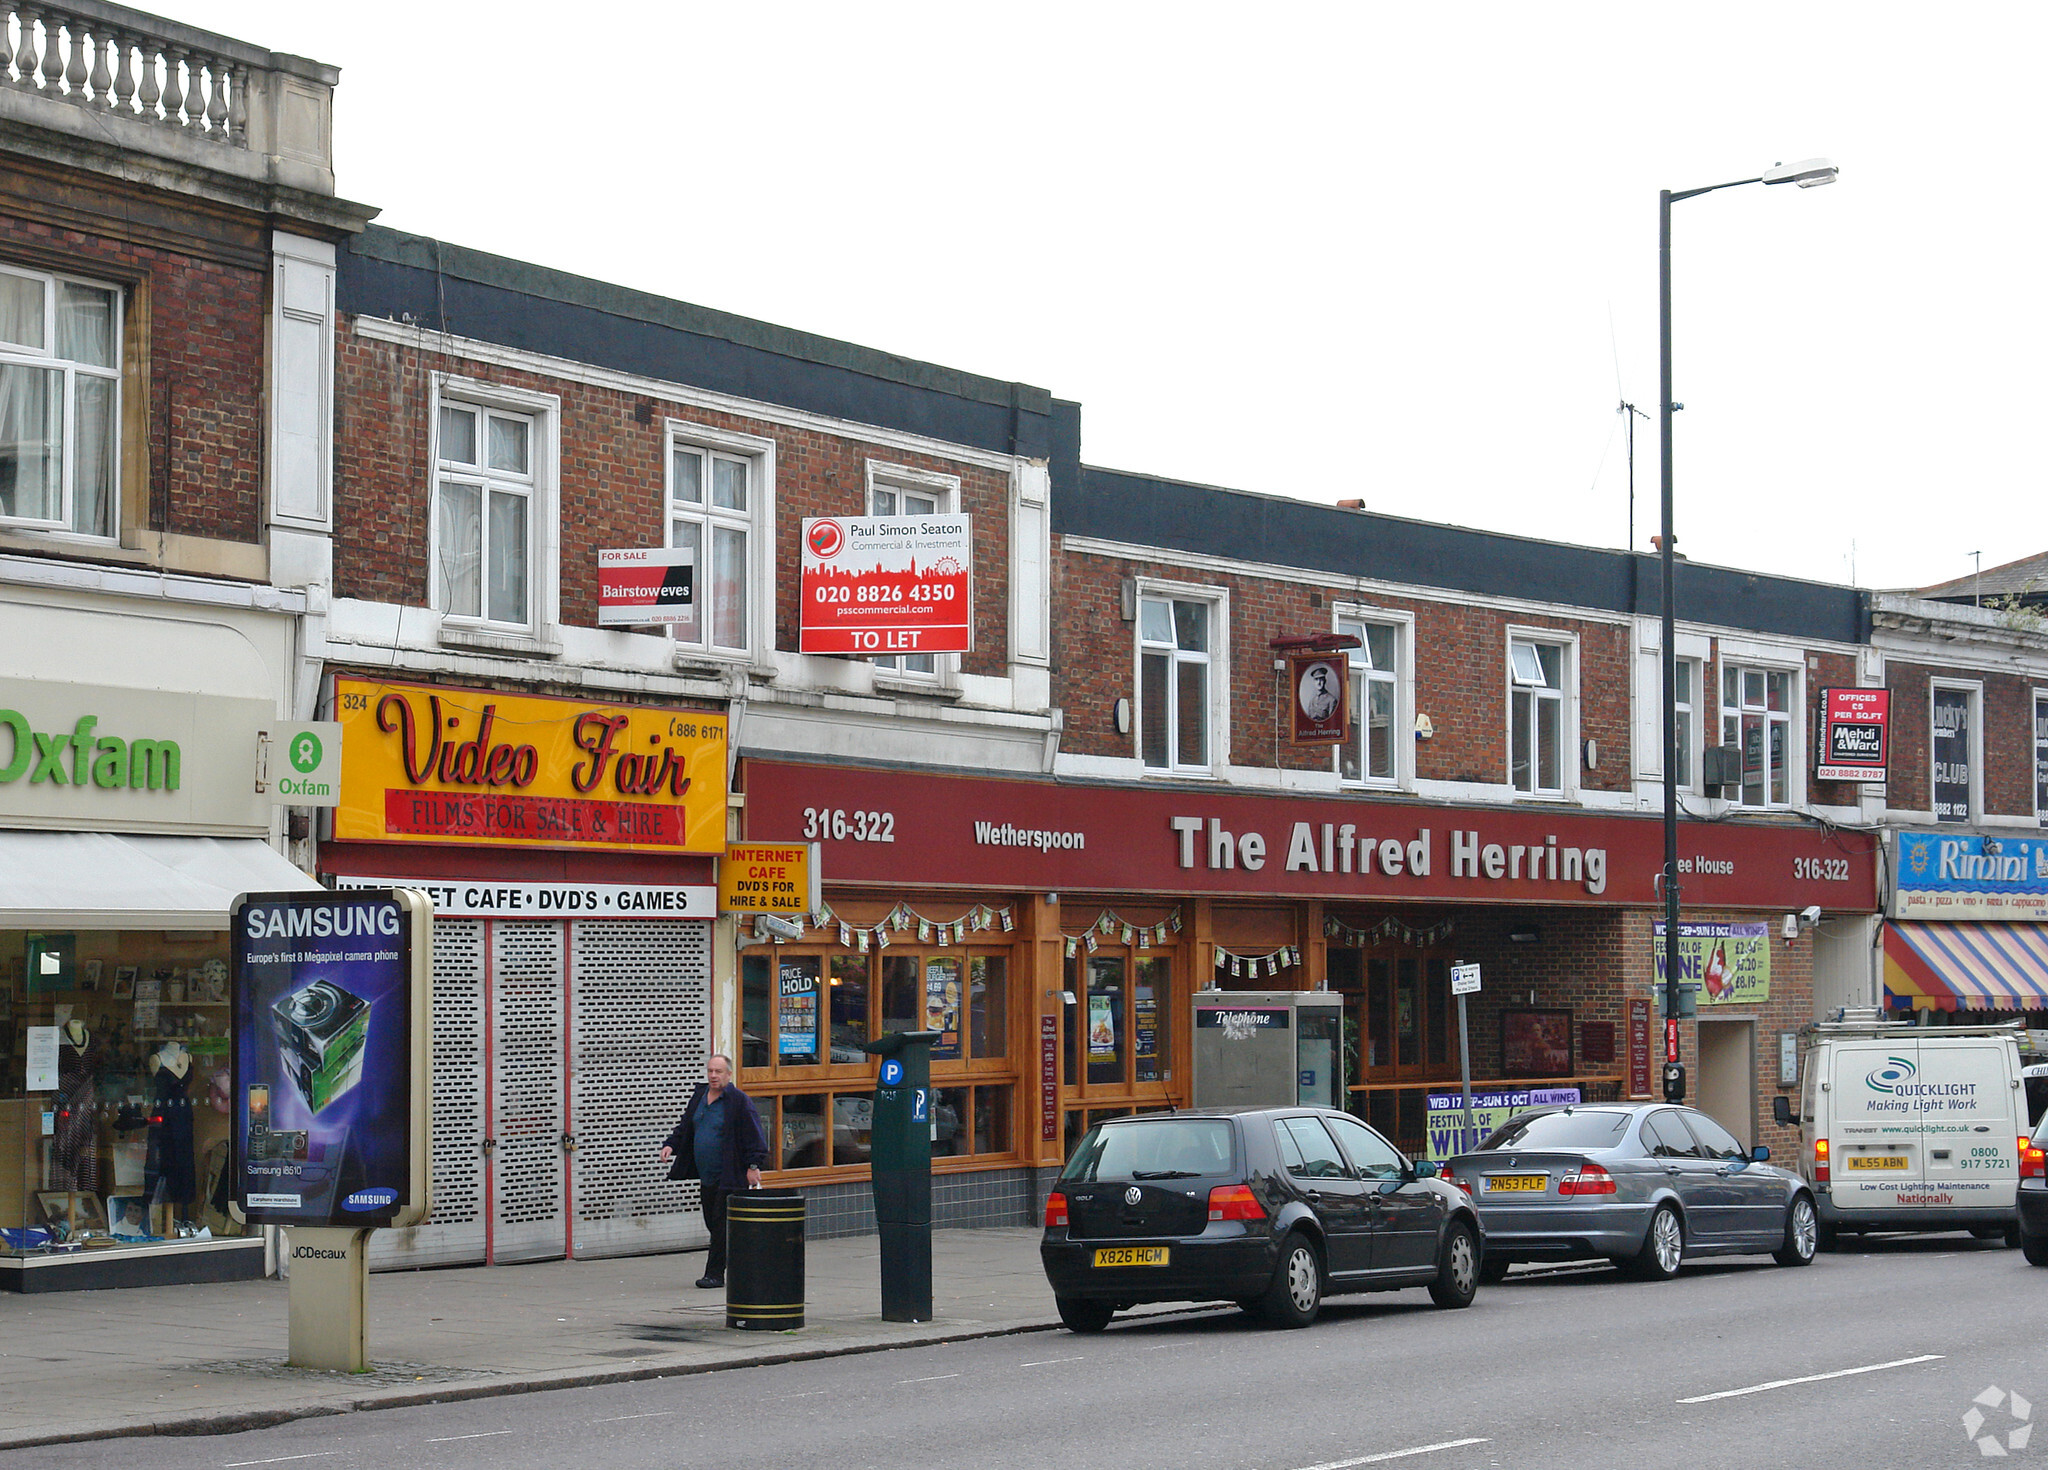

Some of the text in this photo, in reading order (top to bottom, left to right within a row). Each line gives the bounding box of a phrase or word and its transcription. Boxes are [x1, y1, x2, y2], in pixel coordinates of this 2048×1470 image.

[851, 523, 962, 536] Paul Simon Seaton
[852, 540, 961, 550] Commercial & Investment
[602, 552, 647, 560] FOR SALE
[815, 584, 955, 602] 020 8826 4350
[837, 604, 933, 616] psscommercial.com
[851, 631, 922, 648] TO LET
[343, 694, 367, 711] 324
[1934, 703, 1968, 732] ucky's
[677, 723, 723, 741] 886 6171
[1318, 728, 1340, 736] Herring
[1819, 689, 1828, 764] mehdiandward.co.uk
[1834, 727, 1875, 740] Mehdi
[0, 709, 181, 790] Oxfam
[376, 693, 692, 797] Video Fair
[1838, 769, 1859, 777] 8882
[1862, 770, 1883, 778] 8787
[1934, 762, 1968, 784] CLUB
[279, 778, 330, 796] Oxfam
[1953, 803, 1967, 816] 1122
[412, 800, 663, 835] FILMS FOR SALE & HIRE
[803, 807, 895, 842] 316-322
[974, 821, 1085, 853] Wetherspoon
[731, 849, 804, 863] INTERNET
[1170, 816, 1607, 894] The Alfred Herring
[1939, 840, 2029, 882] Rimini
[1696, 855, 1734, 875] House
[1794, 857, 1849, 881] 316-322
[748, 866, 786, 879] CAFE
[772, 882, 794, 892] FOR
[464, 888, 522, 909] CAFE
[617, 891, 688, 910] GAMES
[730, 895, 801, 907] HIRE & SALE
[1908, 895, 1926, 907] pasta
[1936, 897, 1952, 907] pizza
[247, 905, 400, 939] SAMSUNG
[1655, 925, 1667, 935] WE
[1711, 926, 1715, 936] 5
[1716, 926, 1729, 936] OCT
[1732, 926, 1746, 935] ALL
[1691, 942, 1702, 953] OF
[247, 950, 399, 965] Europe's first 8 Megapixel camera phone
[1655, 955, 1702, 979] WNE
[781, 968, 802, 980] PRICE
[782, 977, 812, 994] HOLD
[1735, 976, 1756, 989] £8.19
[1215, 1011, 1270, 1027] Telephone
[887, 1064, 898, 1080] P
[1895, 1084, 1976, 1096] QUICKLIGHT
[1430, 1094, 1528, 1109] WED 17 EP-SUN 5 OCT
[1533, 1092, 1576, 1104] ALL WINES
[1867, 1099, 1977, 1113] Making Light Work
[1430, 1113, 1492, 1128] FESTIVL OF
[1881, 1124, 1969, 1134] www.quicklight.co.uk
[1971, 1147, 1998, 1157] 0800
[1852, 1157, 1903, 1168] WL55 ABN
[1960, 1159, 2010, 1168] 917 5721
[247, 1165, 302, 1176] Samsung i8510
[1490, 1178, 1544, 1190] RN53 FLF
[1860, 1183, 1990, 1192] Low Cost Lighting Maintenance
[348, 1194, 391, 1205] SAMSUNG
[1897, 1193, 1953, 1205] Nationally
[292, 1246, 346, 1259] JCDecaux
[1100, 1249, 1162, 1264] X826 HGM
